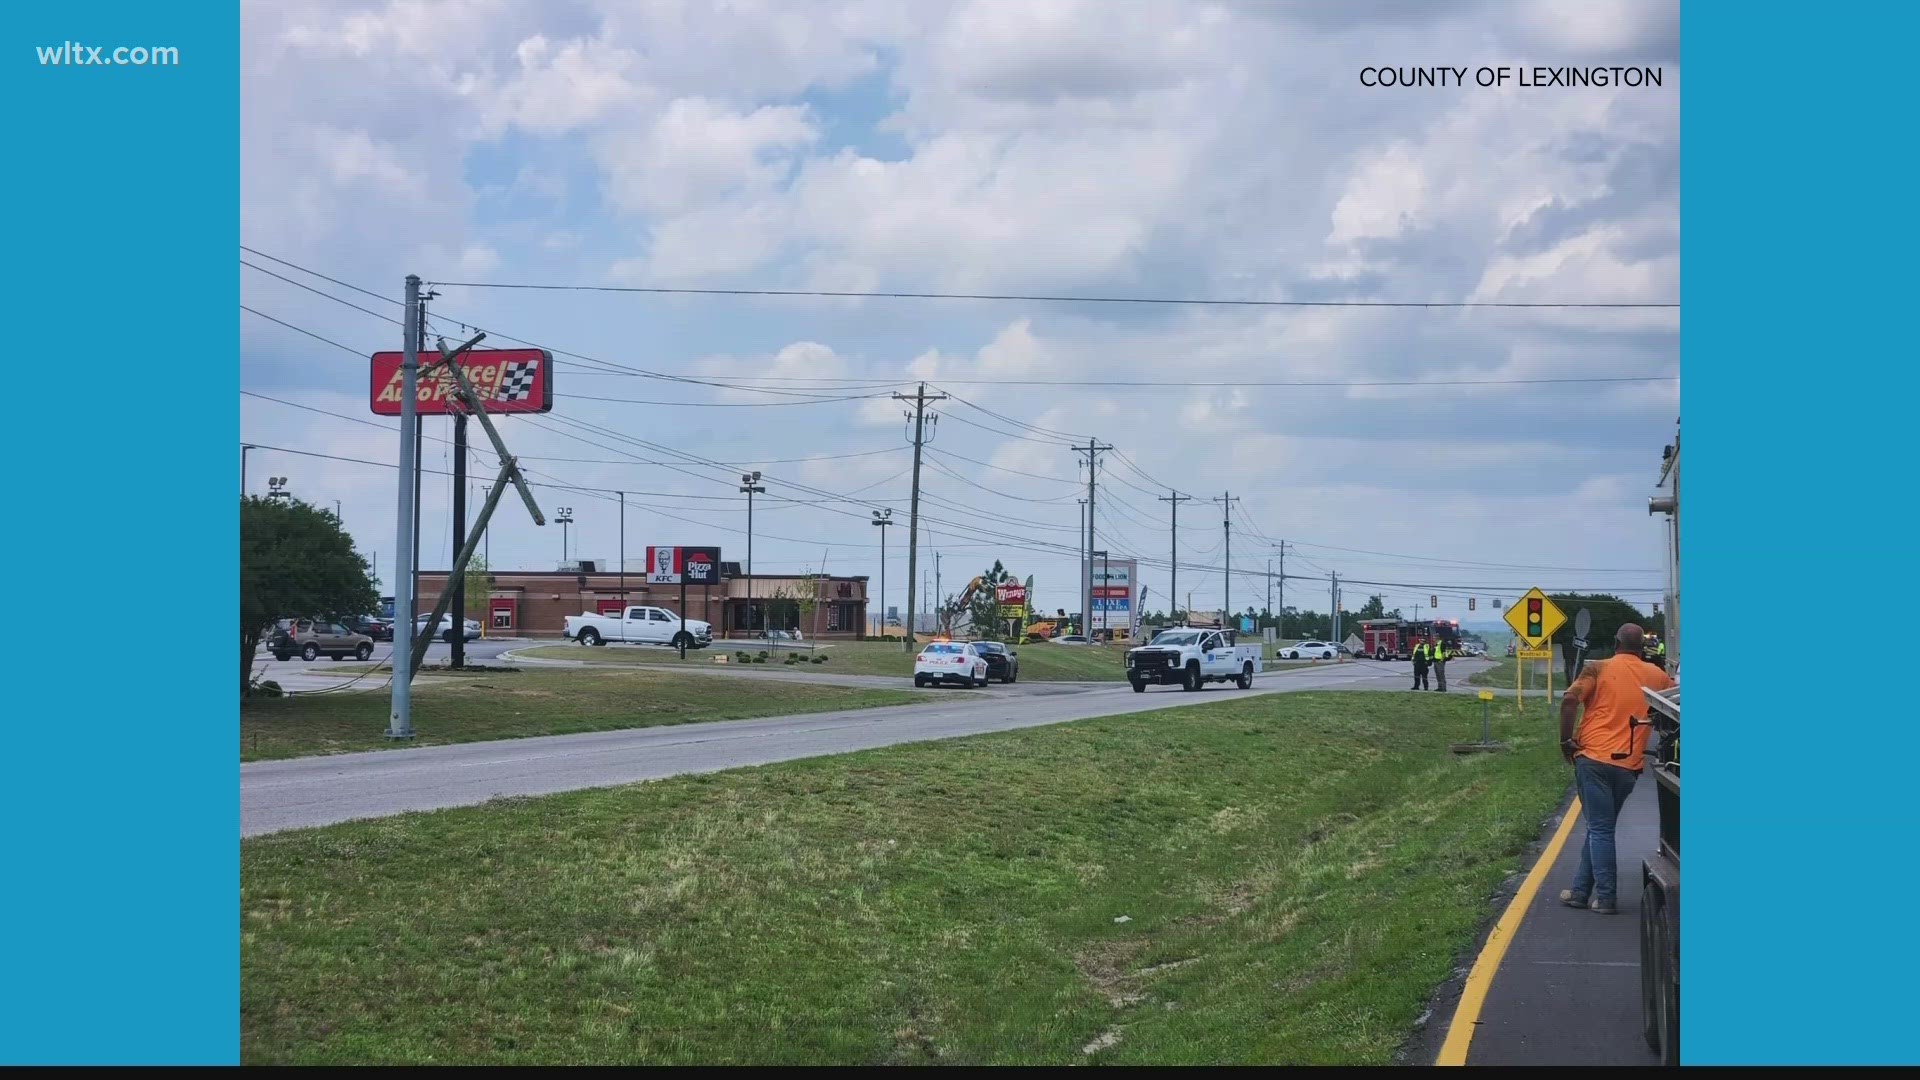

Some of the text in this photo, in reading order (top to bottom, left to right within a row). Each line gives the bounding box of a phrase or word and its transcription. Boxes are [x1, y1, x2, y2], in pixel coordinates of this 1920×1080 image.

[376, 383, 491, 402] Auo Pats
[688, 561, 711, 572] Pizza
[688, 569, 707, 579] Hut
